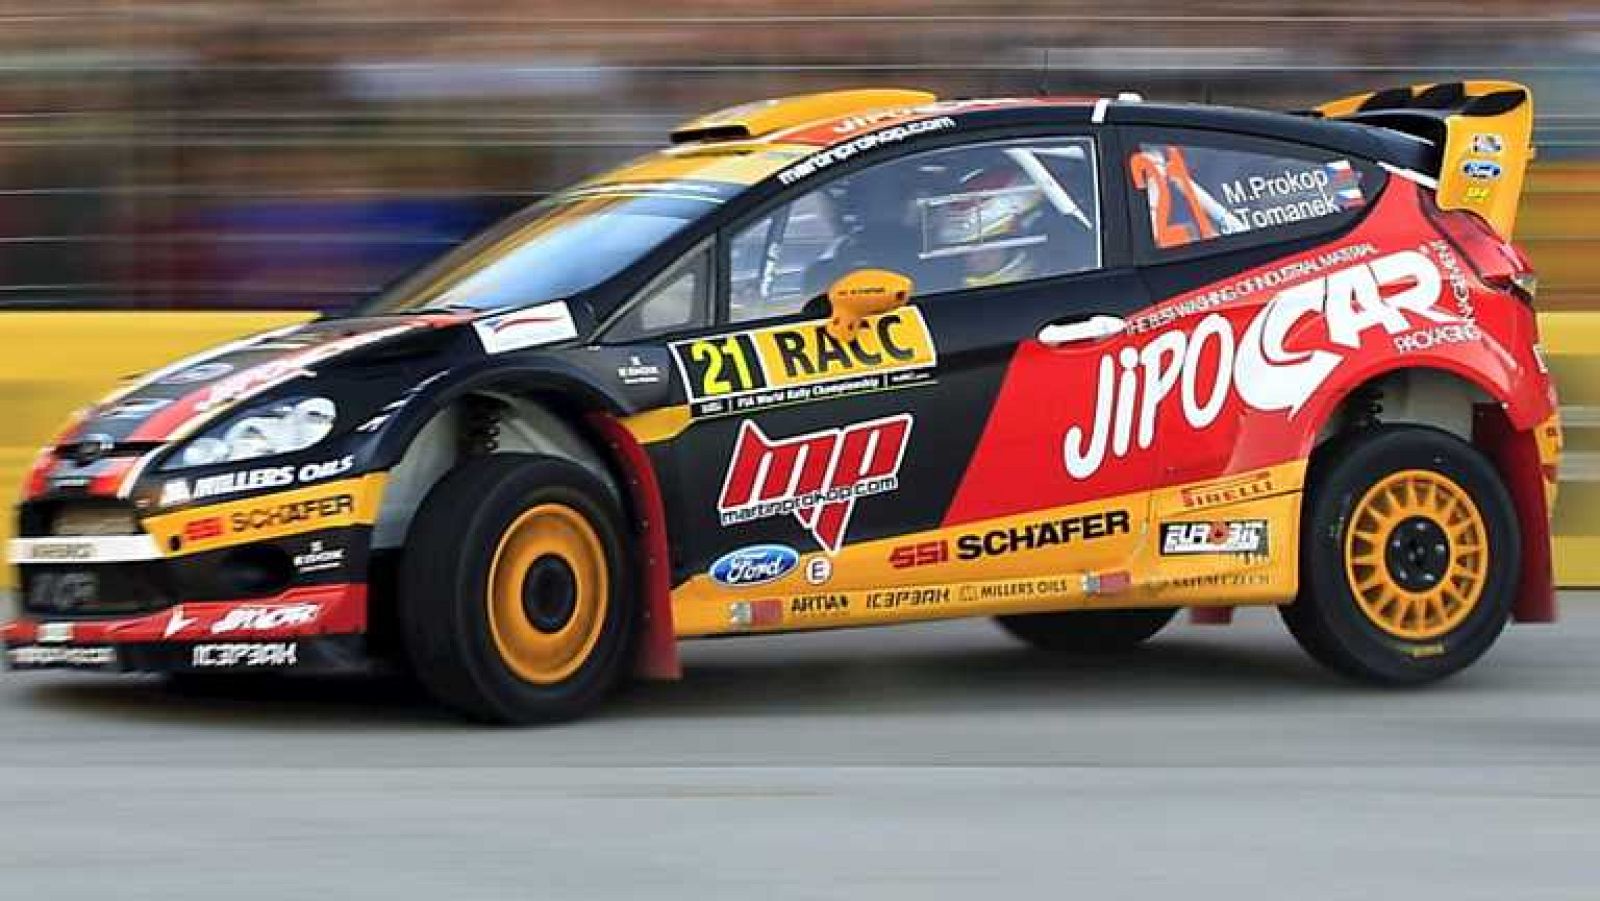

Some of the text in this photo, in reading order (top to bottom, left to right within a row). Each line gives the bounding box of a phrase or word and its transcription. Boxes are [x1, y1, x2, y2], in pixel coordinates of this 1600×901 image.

[1130, 145, 1222, 248] 21
[1221, 168, 1328, 205] M.Prokop
[690, 336, 755, 396] 21
[774, 310, 916, 376] RACC
[888, 510, 1130, 571] SSI SCHÄFER
[979, 583, 1034, 600] MILLERS
